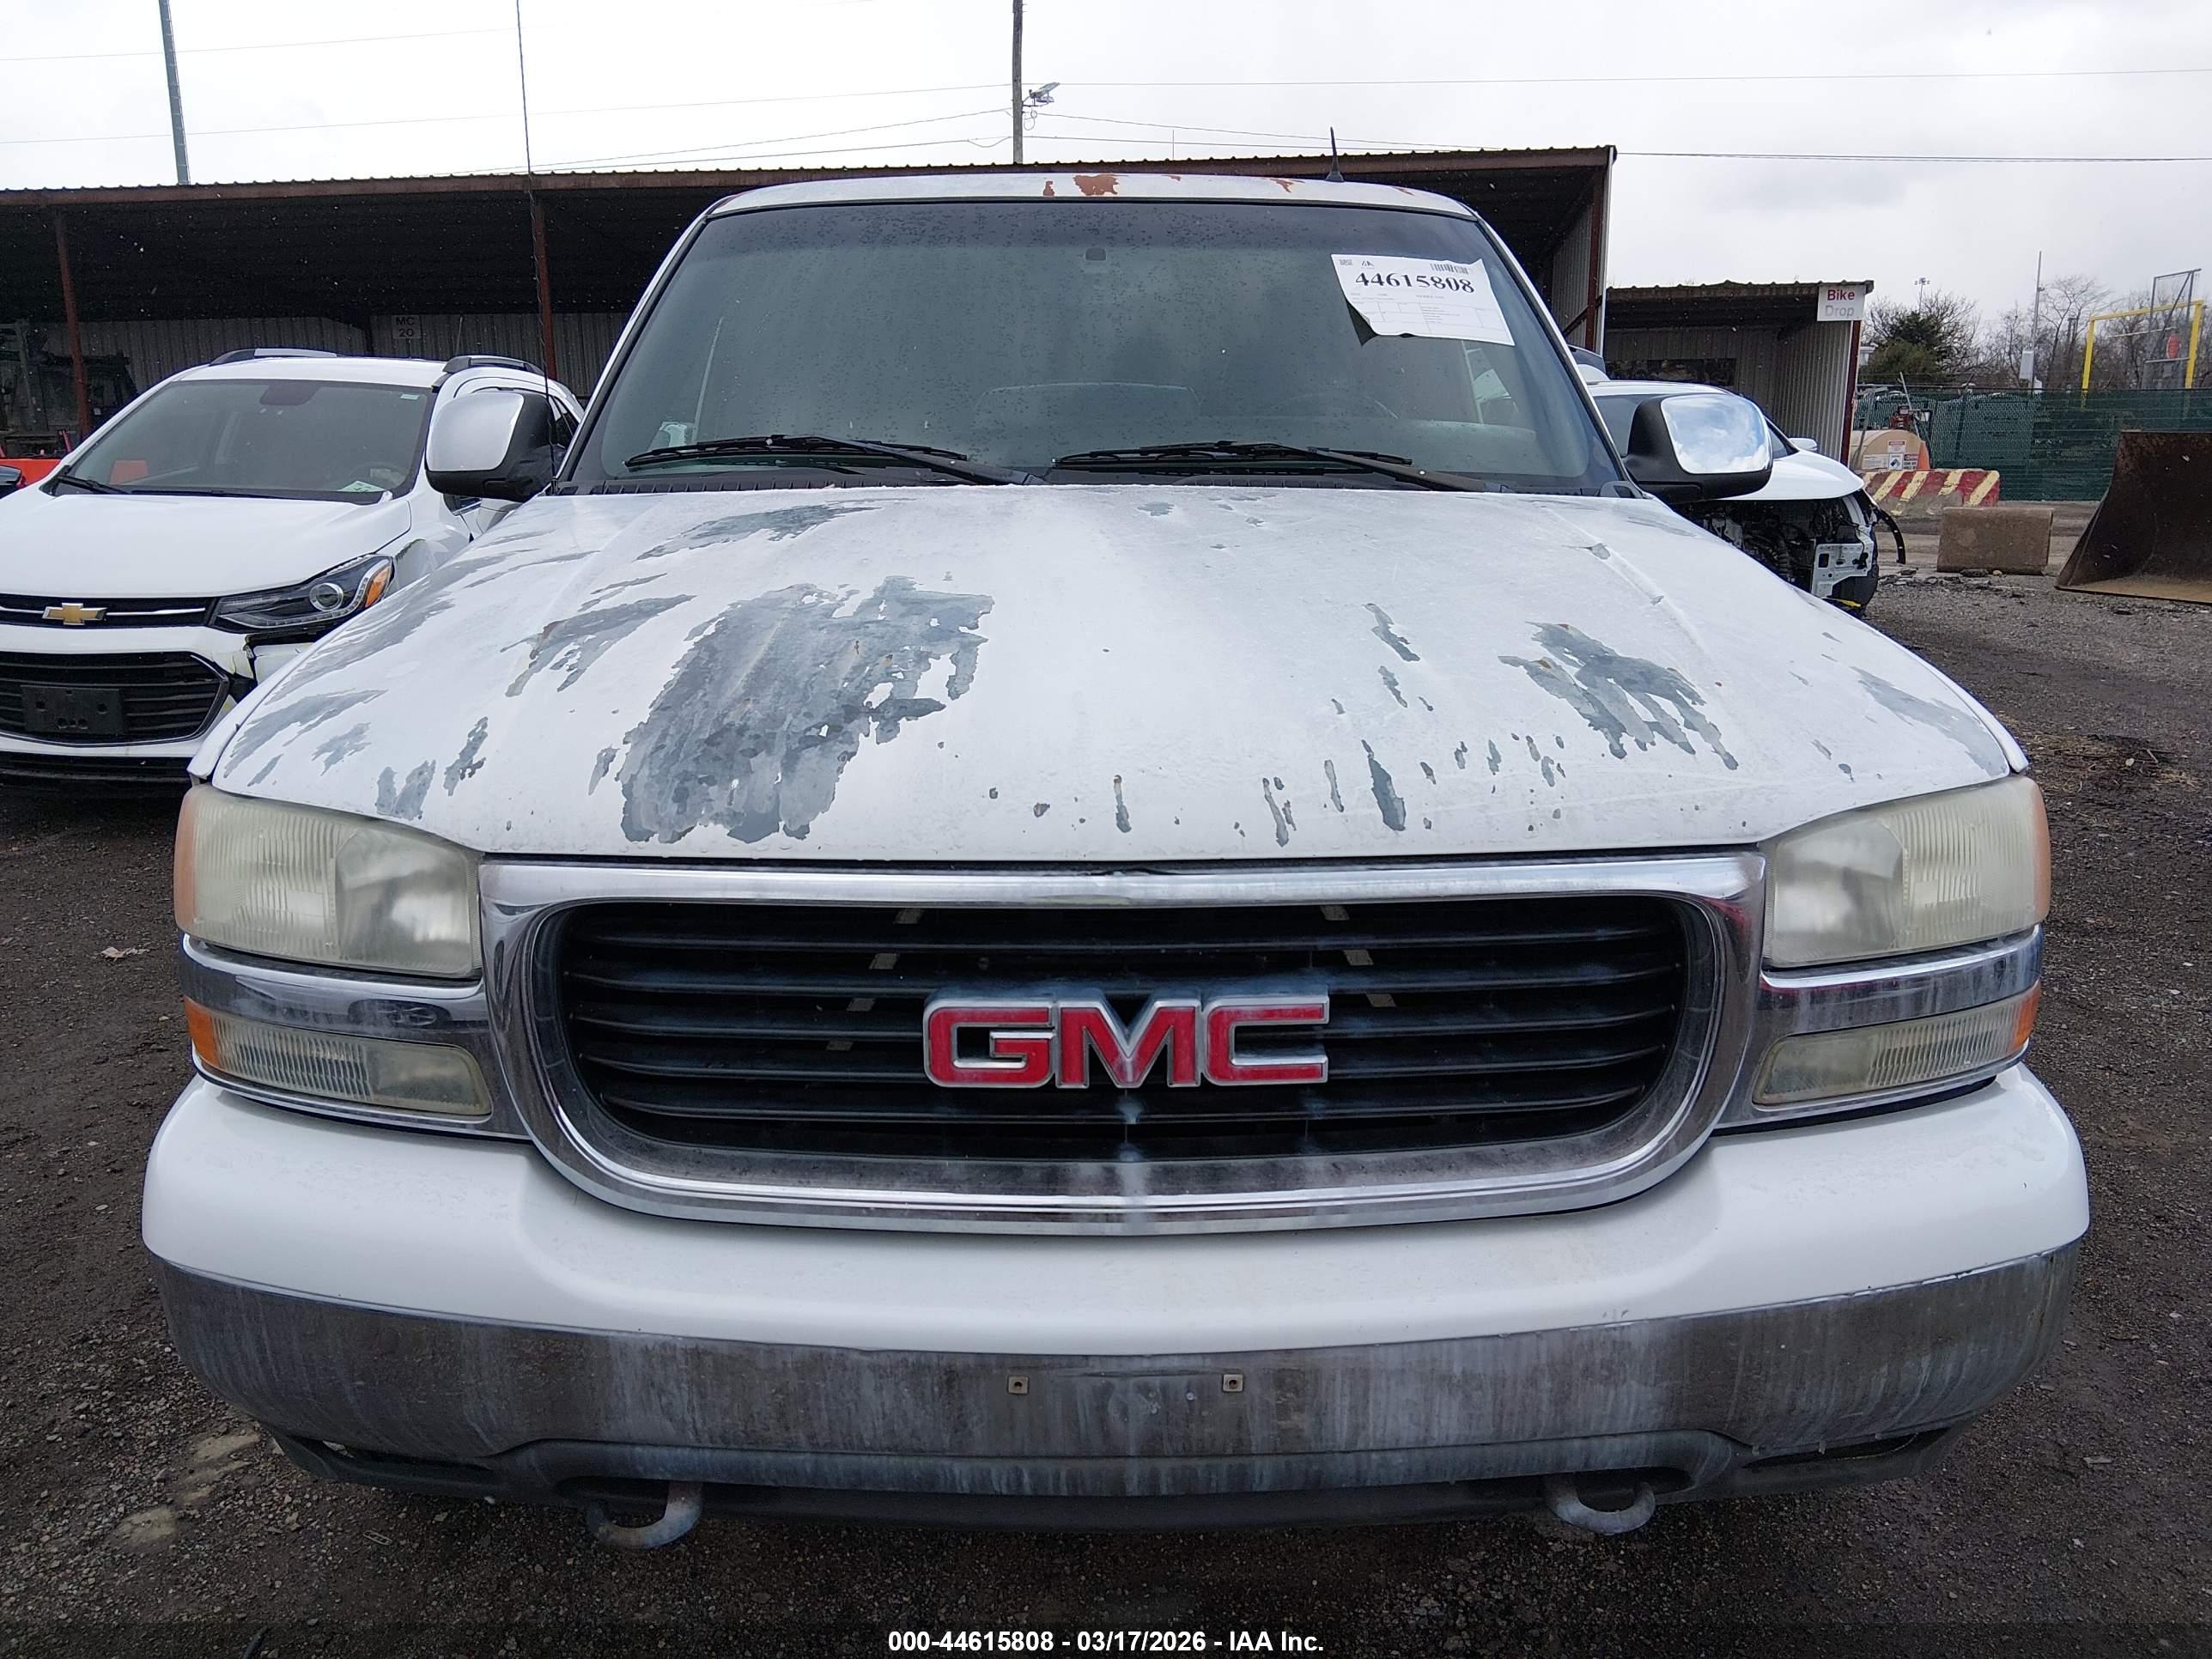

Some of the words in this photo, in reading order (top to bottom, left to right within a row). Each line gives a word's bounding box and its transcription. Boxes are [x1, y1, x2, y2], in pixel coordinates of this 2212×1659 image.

[1355, 272, 1475, 293] 44615808
[1826, 289, 1856, 301] Bike
[1825, 305, 1855, 319] Drop
[396, 316, 414, 325] MC
[398, 328, 414, 337] 20
[923, 997, 1330, 1089] GMC
